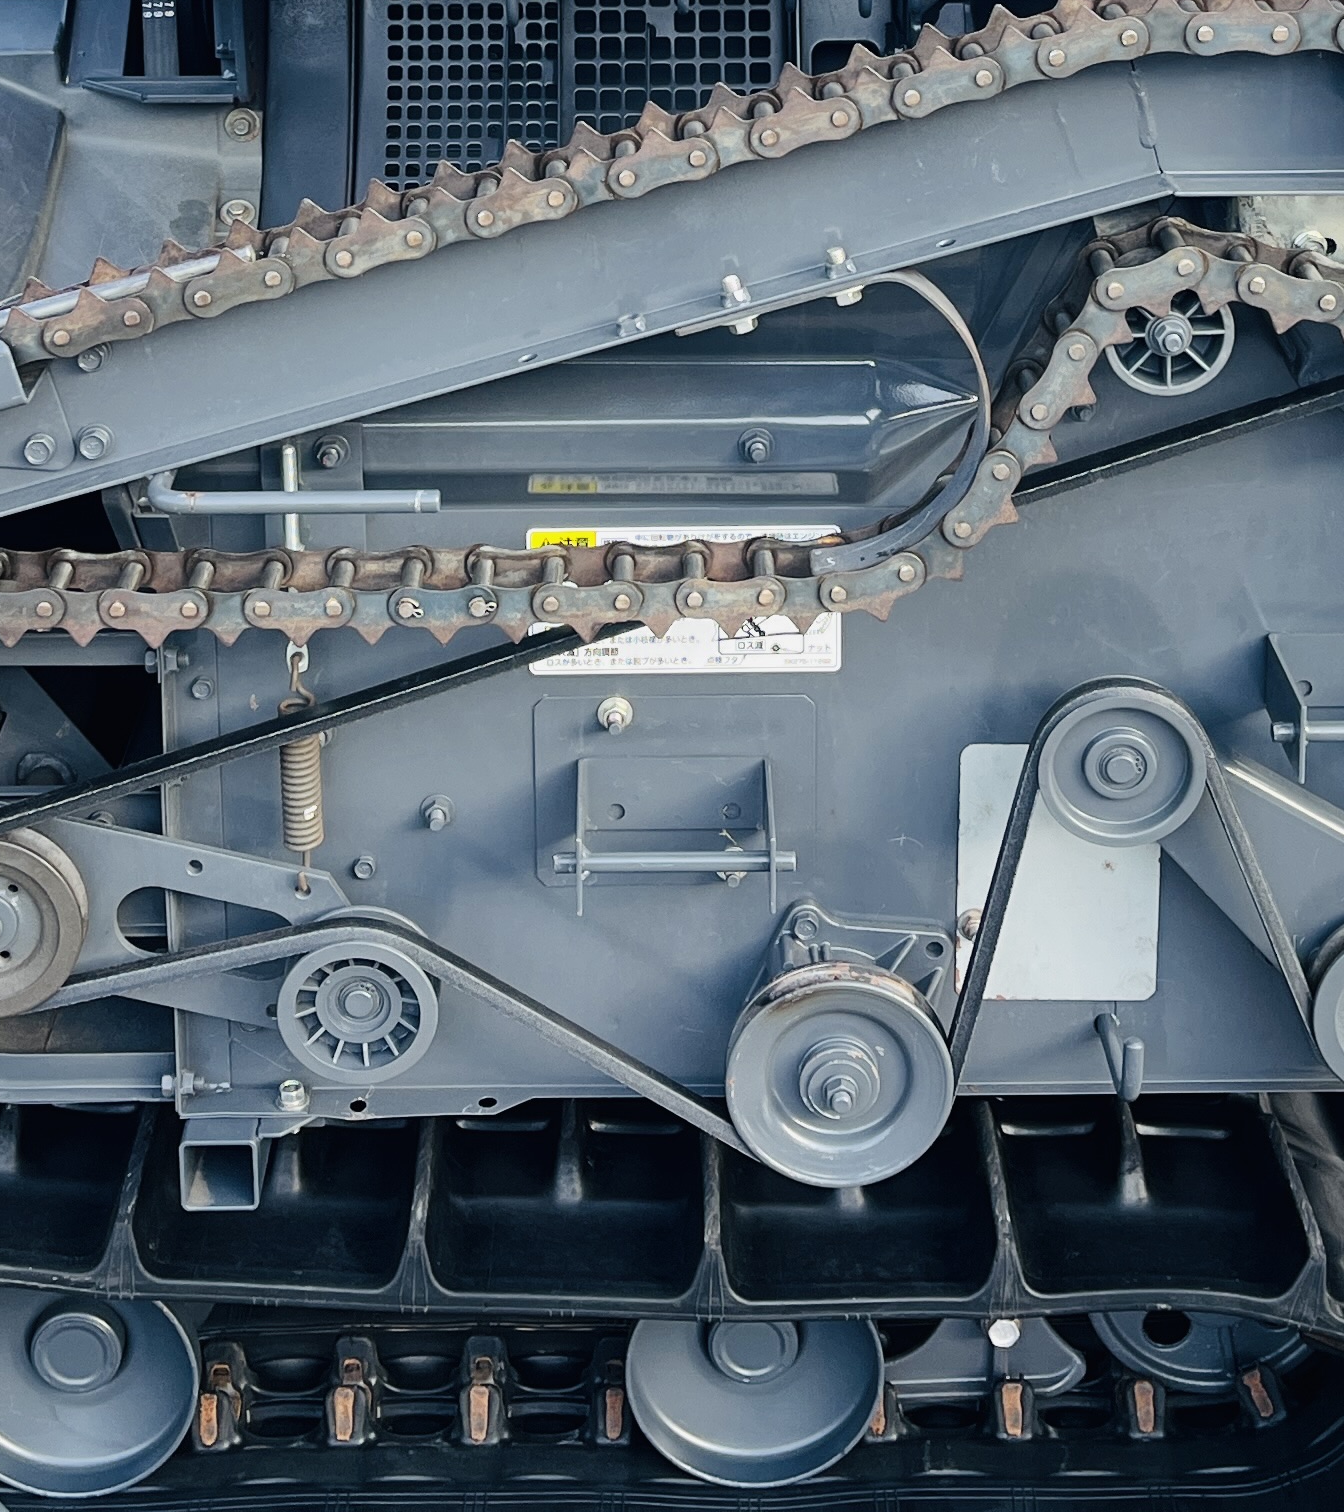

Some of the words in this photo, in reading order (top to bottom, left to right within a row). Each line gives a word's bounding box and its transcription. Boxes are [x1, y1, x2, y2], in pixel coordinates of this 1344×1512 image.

[737, 641, 763, 650] ロス減
[808, 644, 831, 653] ナット
